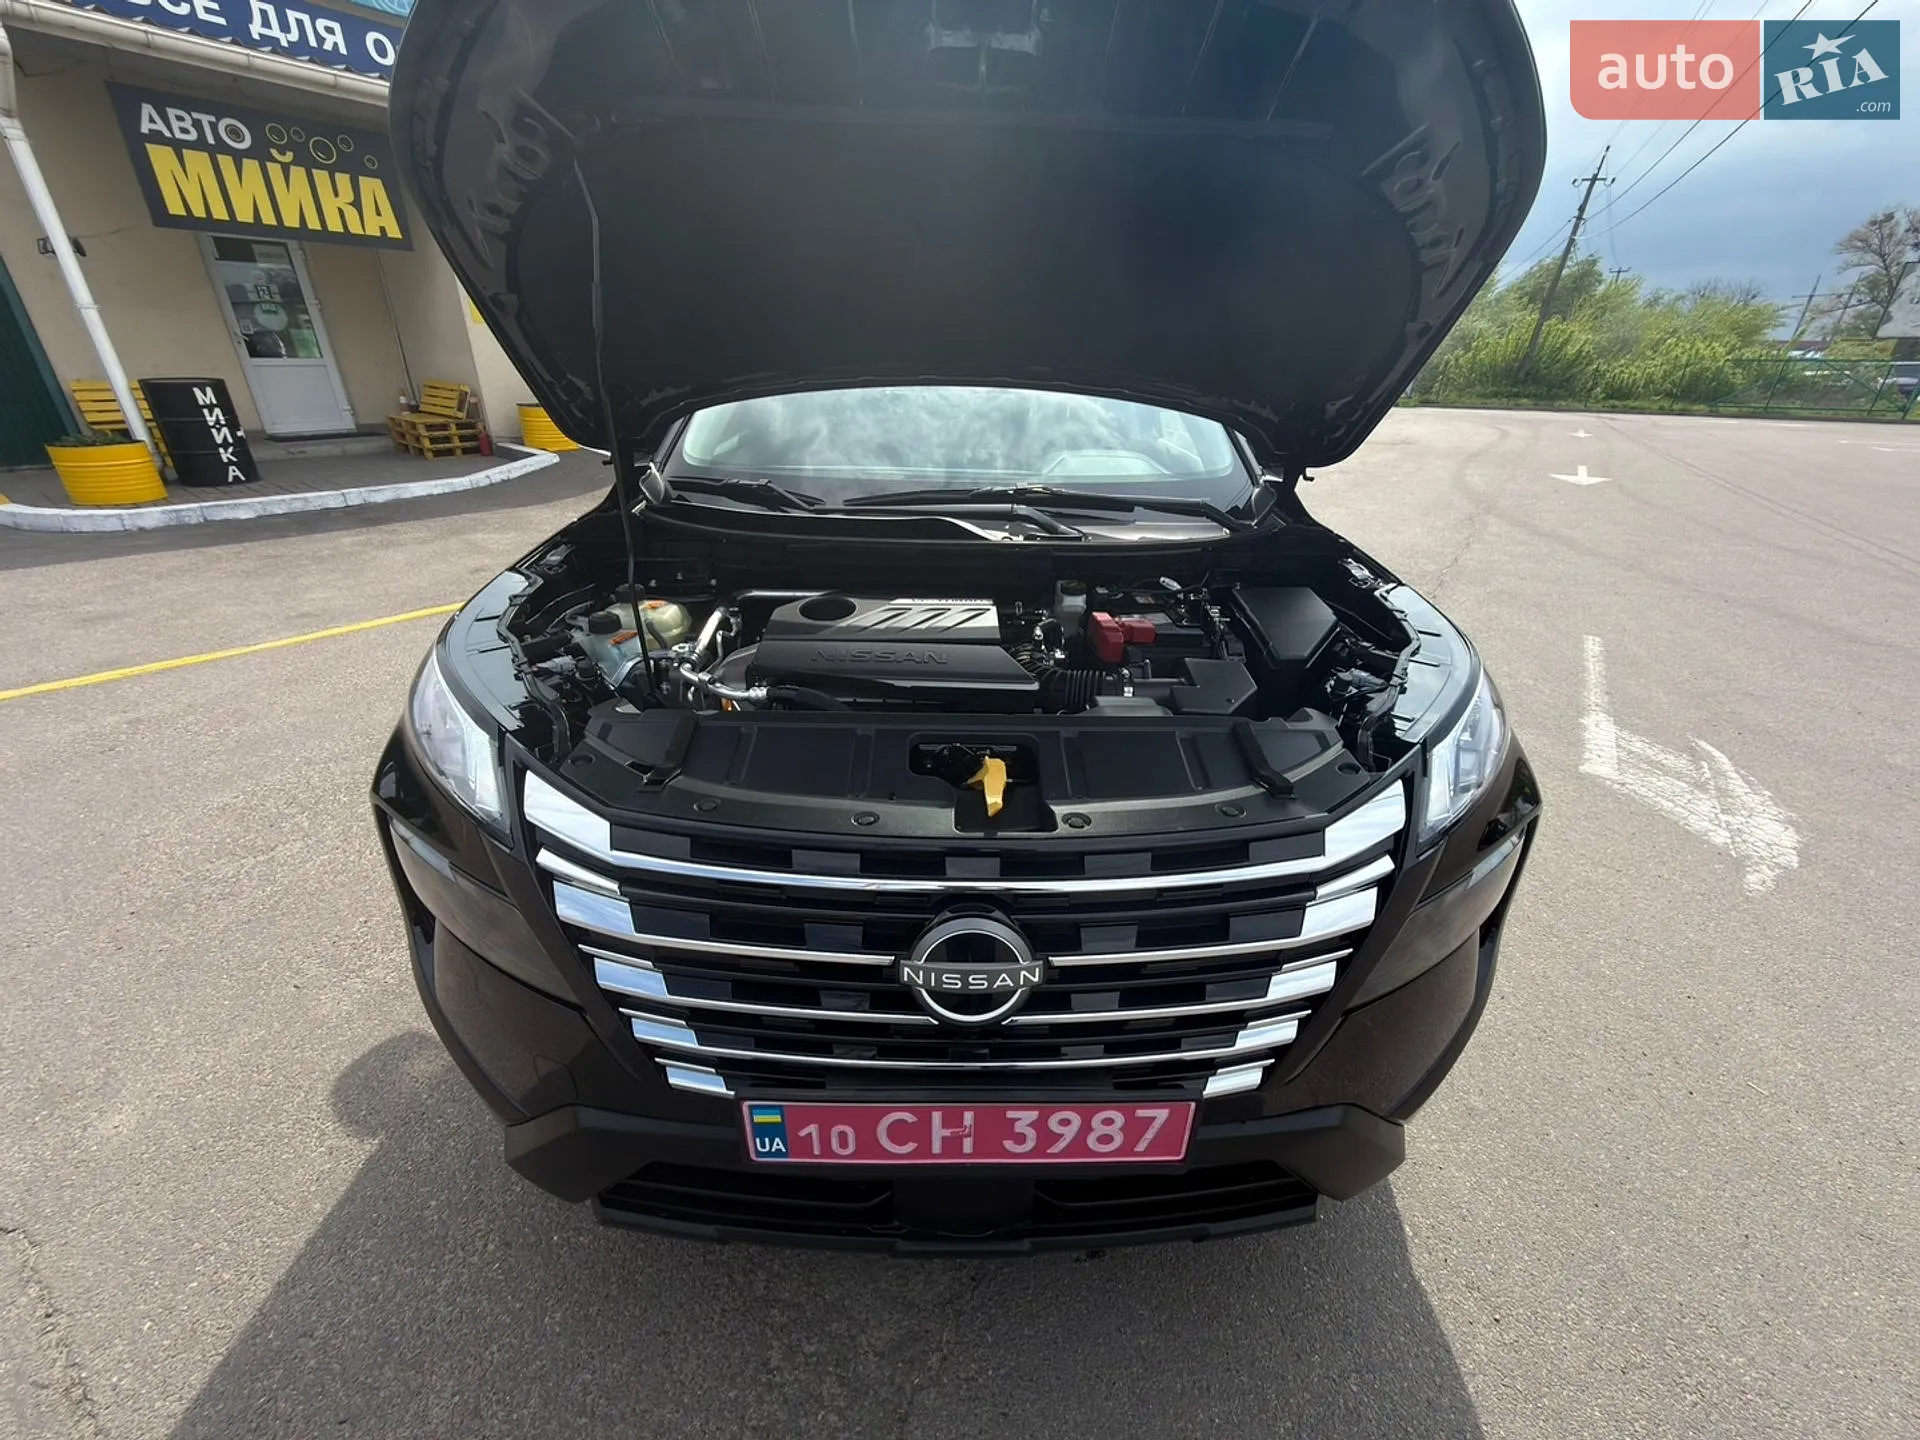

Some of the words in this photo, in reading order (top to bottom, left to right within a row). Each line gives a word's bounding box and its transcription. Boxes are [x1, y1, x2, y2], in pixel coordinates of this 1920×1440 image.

[127, 0, 227, 26] СЕ
[249, 1, 347, 56] ДЛЯ
[140, 103, 252, 150] АВТО
[145, 148, 402, 240] МИЙКА
[192, 386, 246, 482] МИЙКА
[811, 648, 948, 665] NISSAN
[903, 966, 1040, 990] NISSAN
[756, 1137, 786, 1154] UA
[798, 1123, 856, 1156] 10
[876, 1110, 975, 1155] CH
[1002, 1108, 1171, 1154] 3987
